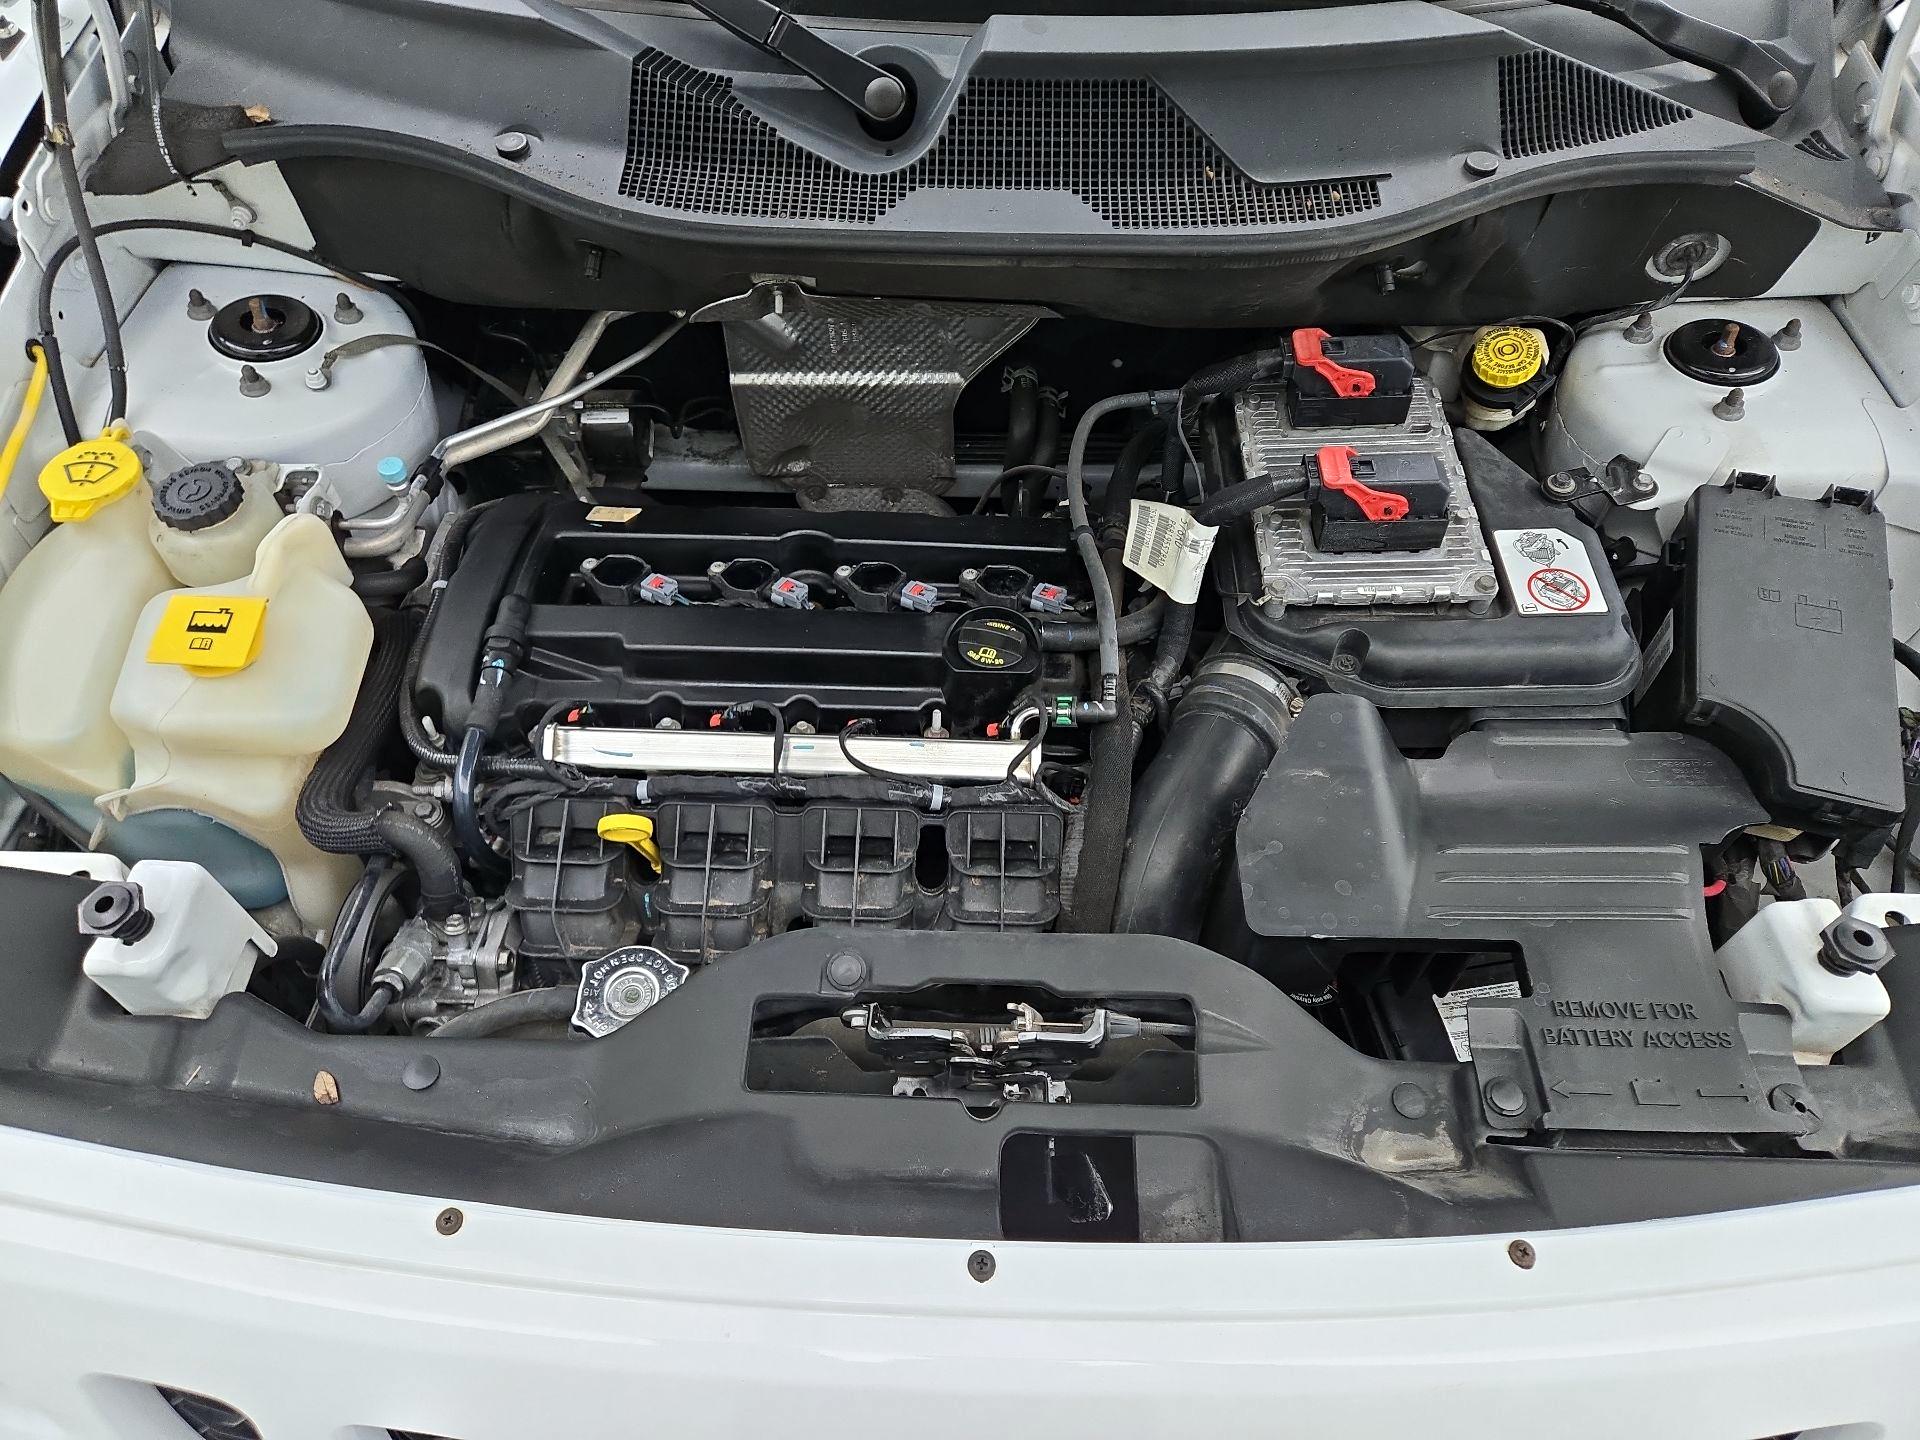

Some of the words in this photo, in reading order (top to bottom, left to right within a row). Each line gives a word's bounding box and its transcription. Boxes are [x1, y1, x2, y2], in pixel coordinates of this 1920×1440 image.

[1493, 361, 1516, 369] BEFORE
[609, 953, 644, 967] OPEN
[645, 956, 670, 975] NOT
[589, 963, 610, 987] HOT
[1550, 999, 1648, 1020] REMOVE
[1649, 1001, 1700, 1020] FOR
[1541, 1027, 1636, 1048] BATTERY
[1643, 1030, 1736, 1049] ACCESS
